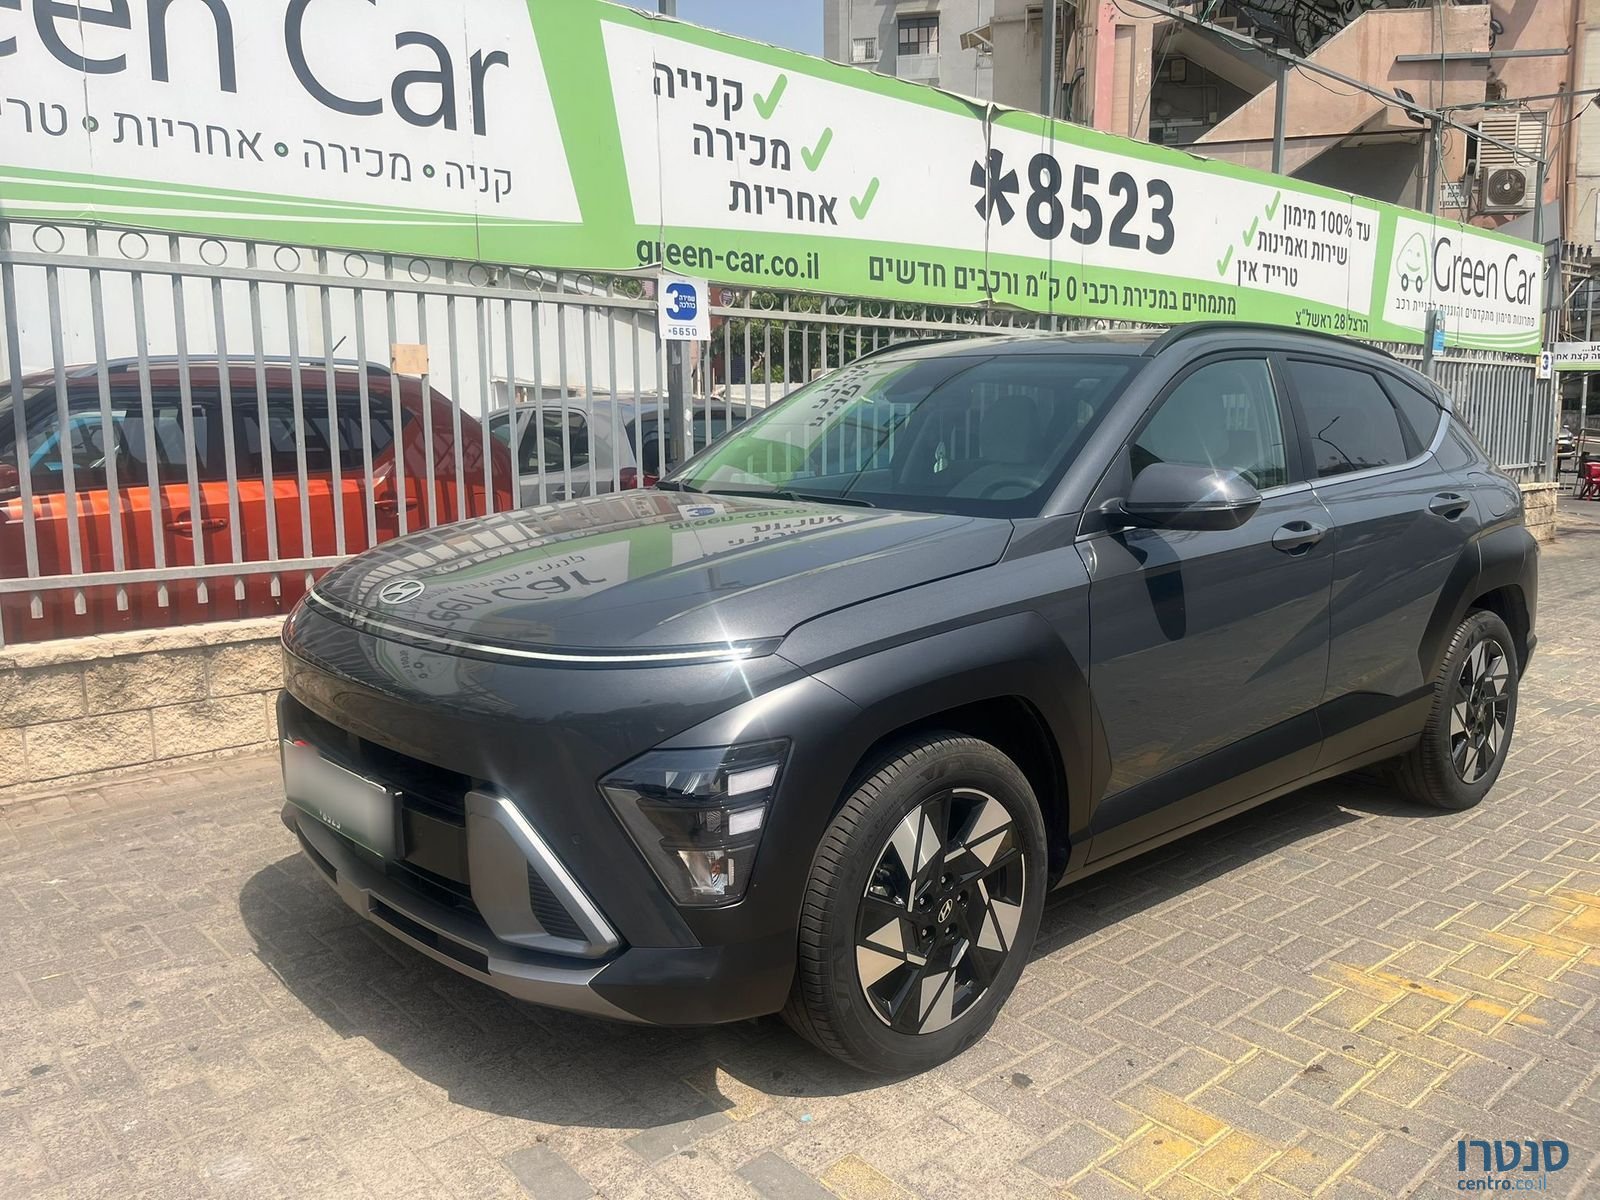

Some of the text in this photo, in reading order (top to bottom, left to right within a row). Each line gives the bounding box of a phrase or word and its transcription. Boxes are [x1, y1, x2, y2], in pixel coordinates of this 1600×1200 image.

[0, 0, 509, 137] en Car
[653, 61, 743, 121] קנייה
[0, 97, 512, 202] קניה מכירה אחריות טר
[693, 123, 791, 171] מכירה
[728, 180, 838, 225] אחריות
[1283, 204, 1371, 241] עד 100% מימון
[636, 239, 819, 280] green-car.co.il
[1257, 231, 1348, 265] שירות ואמינות
[869, 255, 946, 289] חדשים
[955, 265, 1019, 298] ורכבים
[1237, 259, 1298, 287] טרייד אין
[1433, 237, 1536, 306] Green Car
[1066, 276, 1077, 302] 0
[1083, 281, 1118, 305] רכבי
[1123, 284, 1178, 311] במכירת
[1182, 295, 1236, 316] מתמחים
[1395, 297, 1410, 310] רכב
[1334, 313, 1346, 330] 28
[1348, 314, 1368, 333] הרצל
[1570, 353, 1589, 362] קצת
